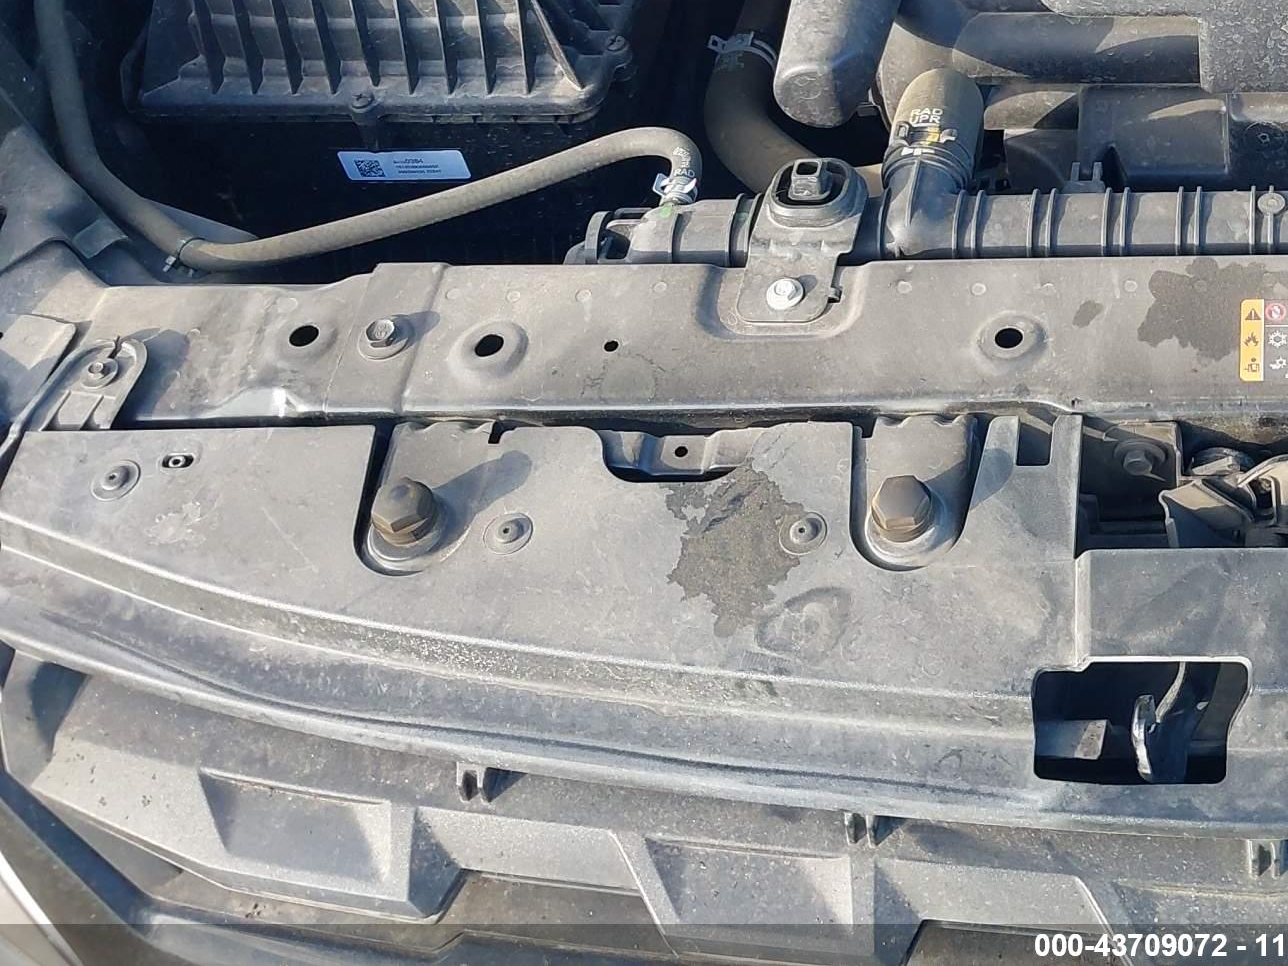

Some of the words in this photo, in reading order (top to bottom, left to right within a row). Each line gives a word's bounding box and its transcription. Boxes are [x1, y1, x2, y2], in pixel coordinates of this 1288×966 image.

[910, 107, 944, 116] RAD
[909, 115, 941, 125] UPR
[673, 168, 696, 178] RAD
